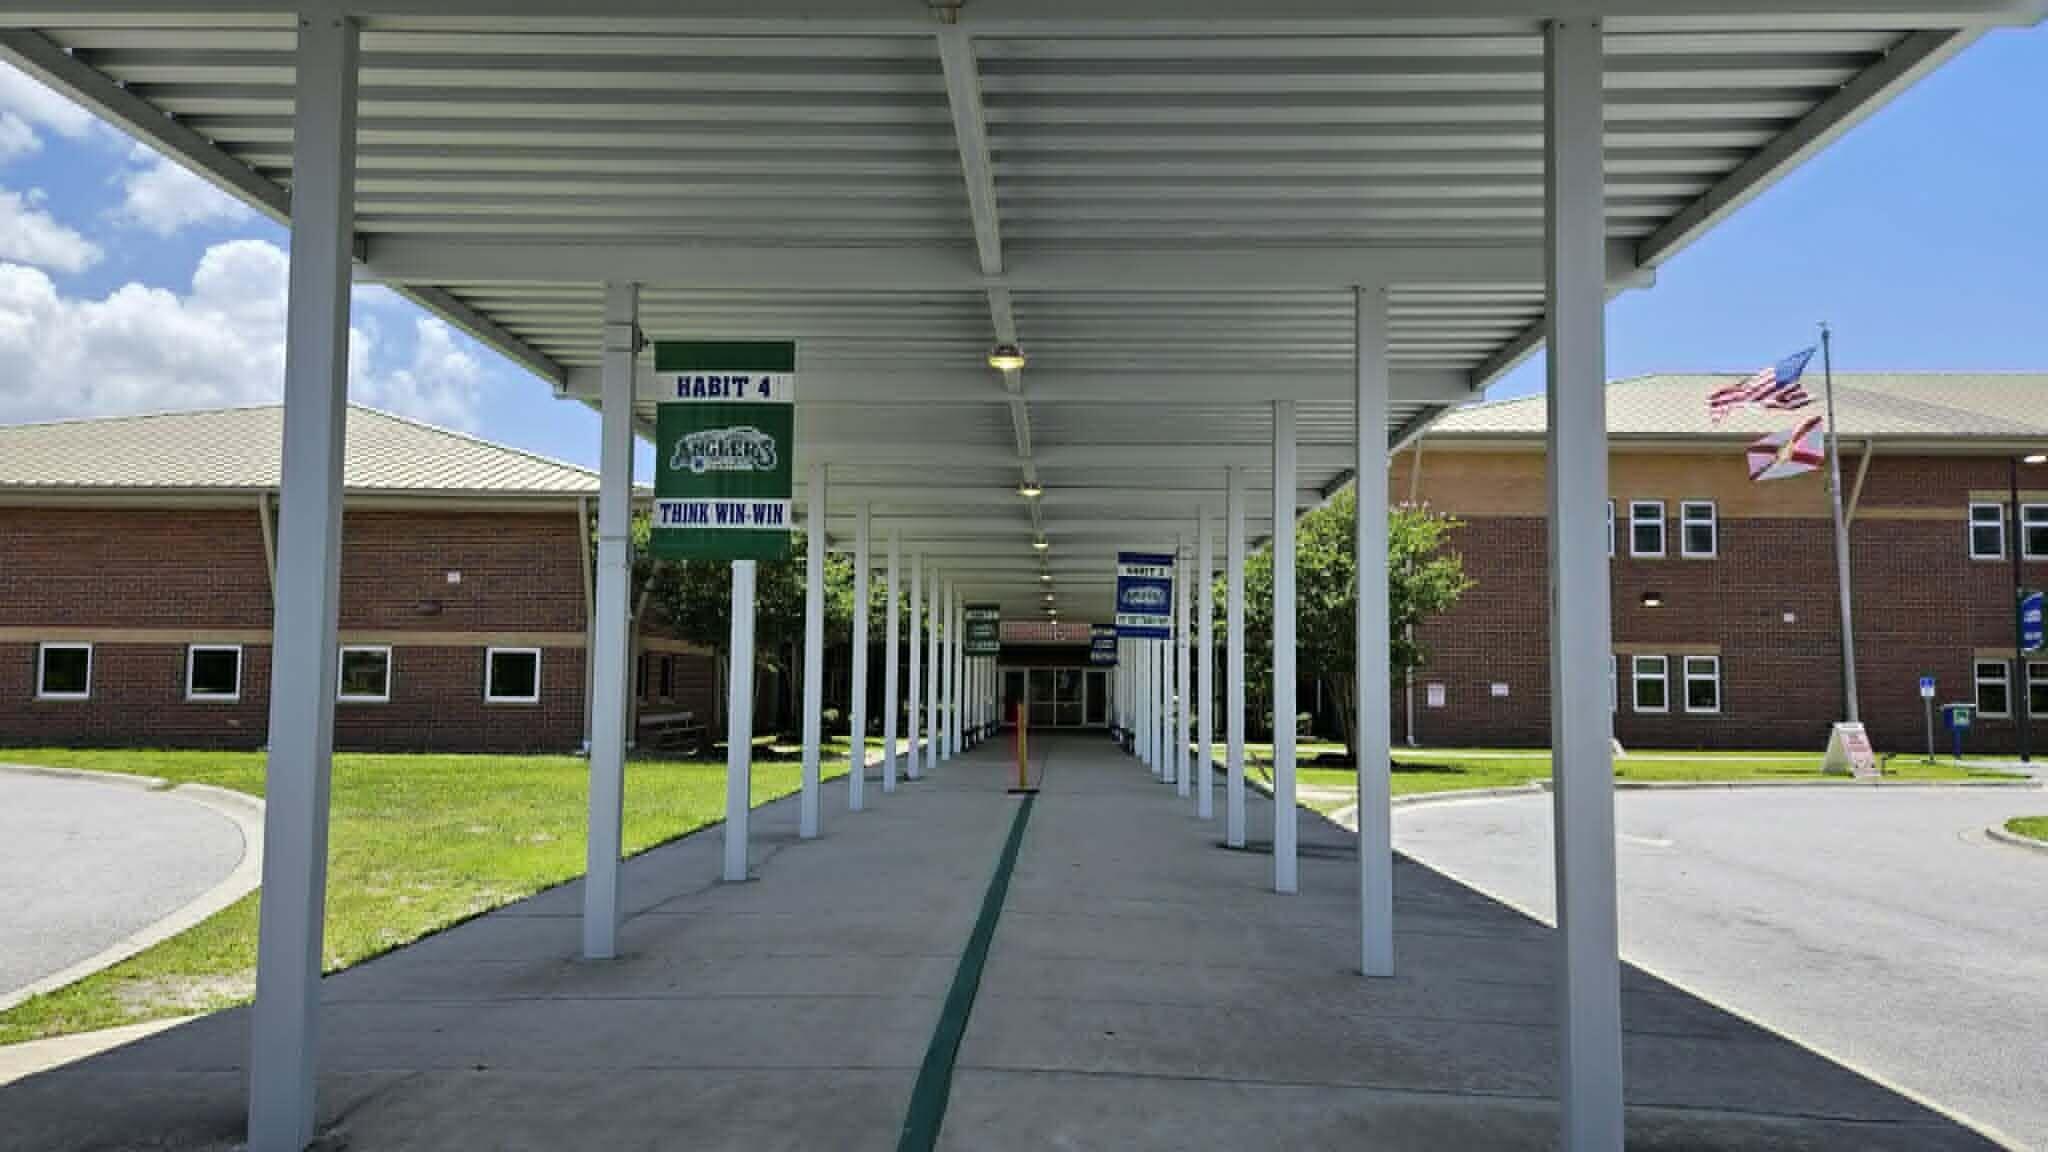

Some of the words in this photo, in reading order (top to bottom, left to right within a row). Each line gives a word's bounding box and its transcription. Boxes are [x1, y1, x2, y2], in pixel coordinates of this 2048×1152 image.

[677, 376, 749, 397] HABIT
[758, 376, 770, 397] 4
[671, 438, 777, 469] ANGLERS
[660, 503, 709, 524] THINK
[715, 503, 784, 524] WIN-WIN
